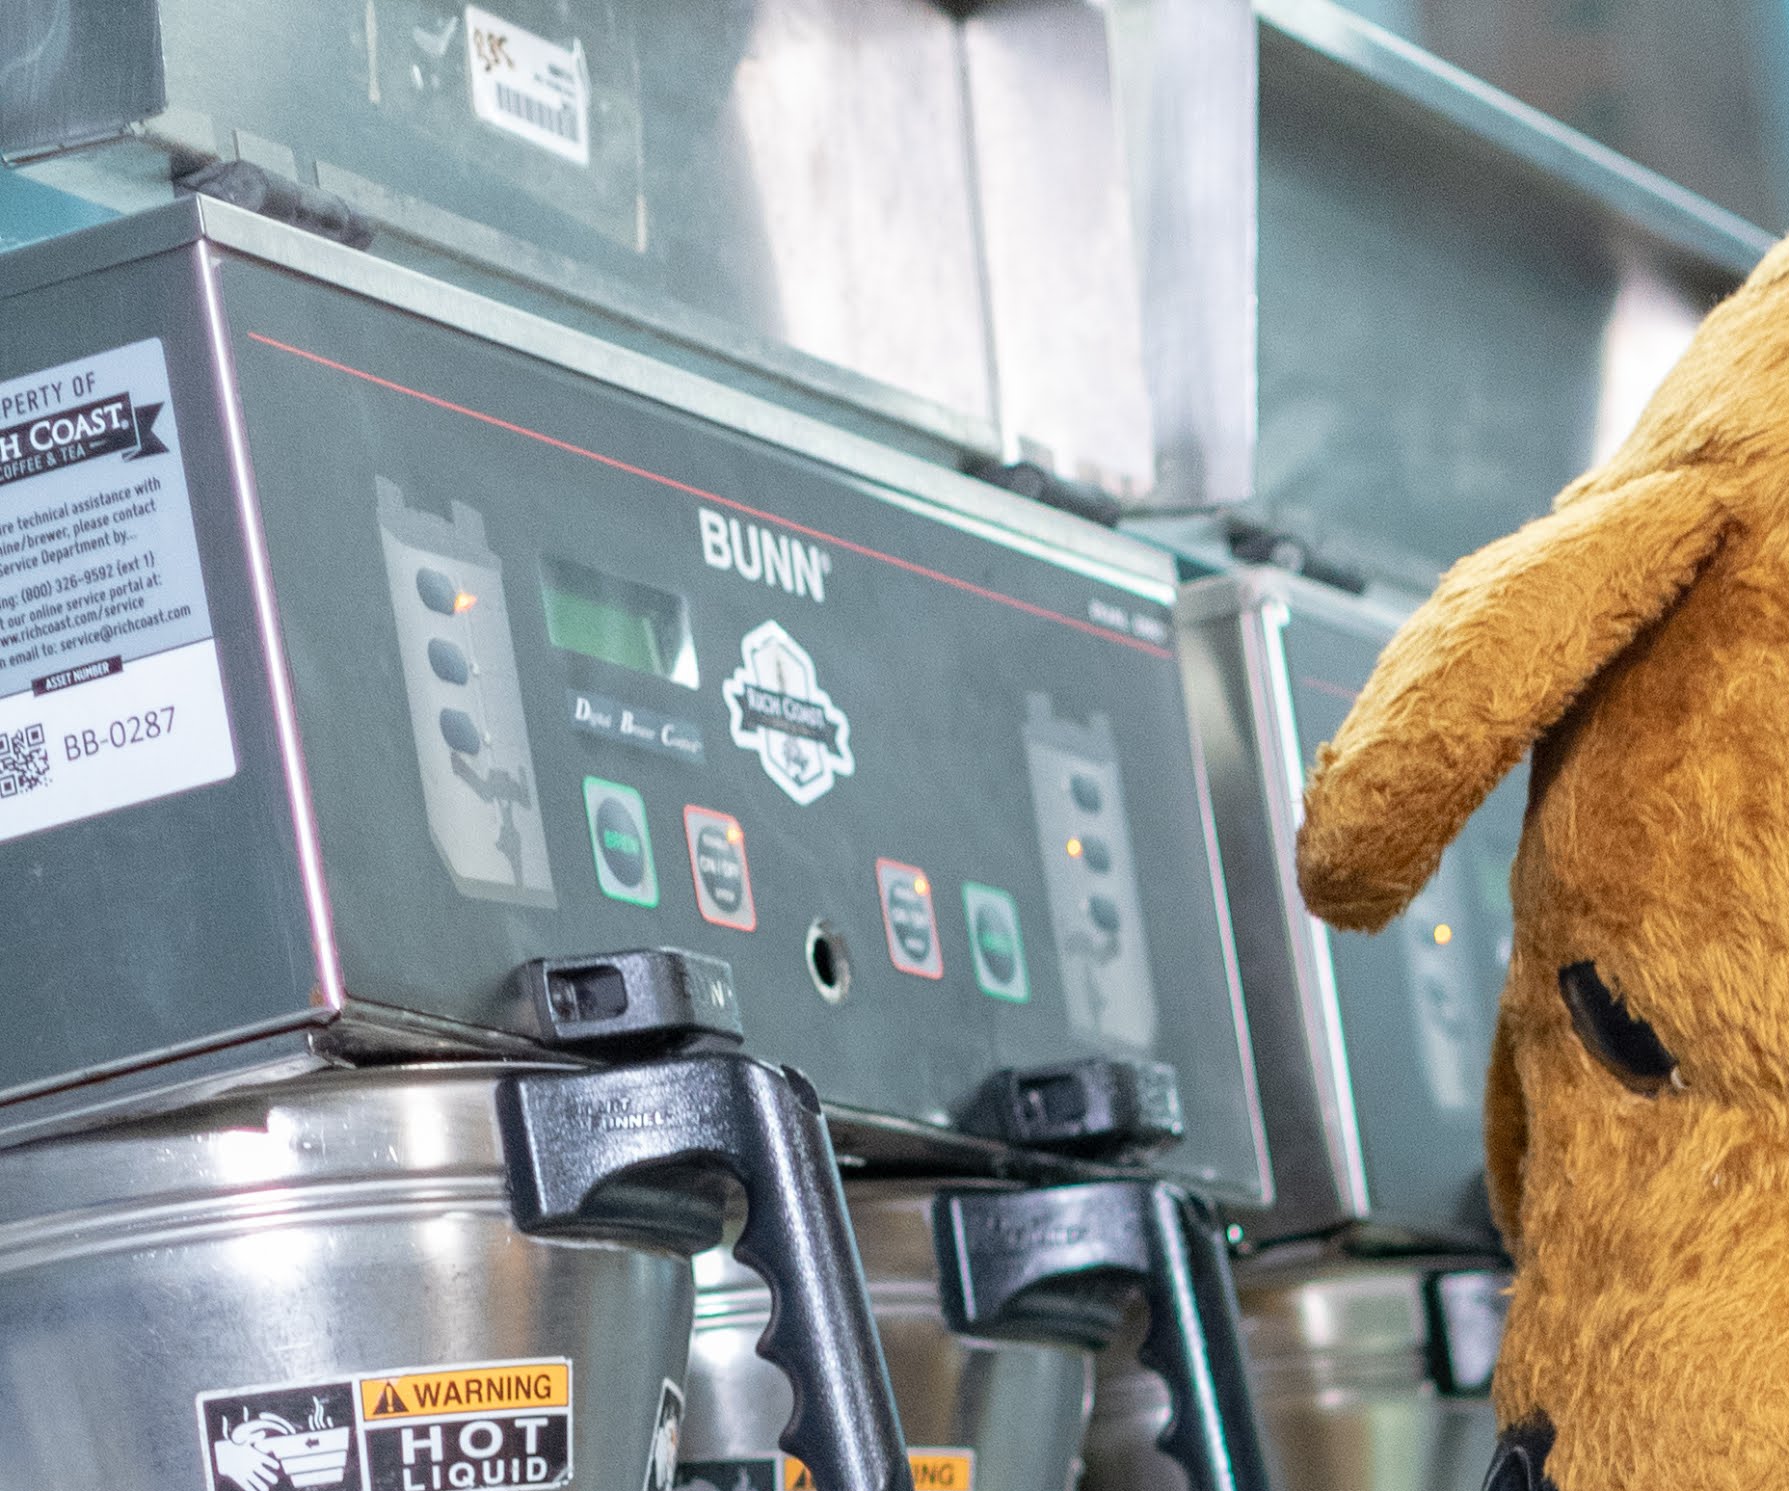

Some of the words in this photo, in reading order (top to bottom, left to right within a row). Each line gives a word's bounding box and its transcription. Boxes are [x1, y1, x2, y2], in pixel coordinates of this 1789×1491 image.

[72, 371, 96, 397] OF
[46, 451, 57, 467] &
[61, 441, 87, 461] TEA
[0, 521, 14, 536] re
[17, 502, 69, 532] technical
[72, 487, 132, 516] assistance
[134, 476, 161, 497] with
[73, 513, 110, 538] please
[112, 498, 157, 524] contact
[41, 531, 110, 565] Department
[0, 595, 18, 611] ng:
[21, 580, 52, 605] (800)
[55, 564, 113, 594] 326-9592
[8, 612, 25, 629] our
[30, 603, 63, 623] online
[66, 590, 106, 612] service
[110, 576, 144, 600] portal
[9, 645, 39, 668] email
[60, 604, 192, 652] service@richcoast.com
[45, 671, 72, 691] ASSET
[73, 661, 110, 682] NUMBER
[64, 705, 175, 762] BB-0287
[413, 1373, 552, 1408] WARNING
[401, 1417, 549, 1466] HOT
